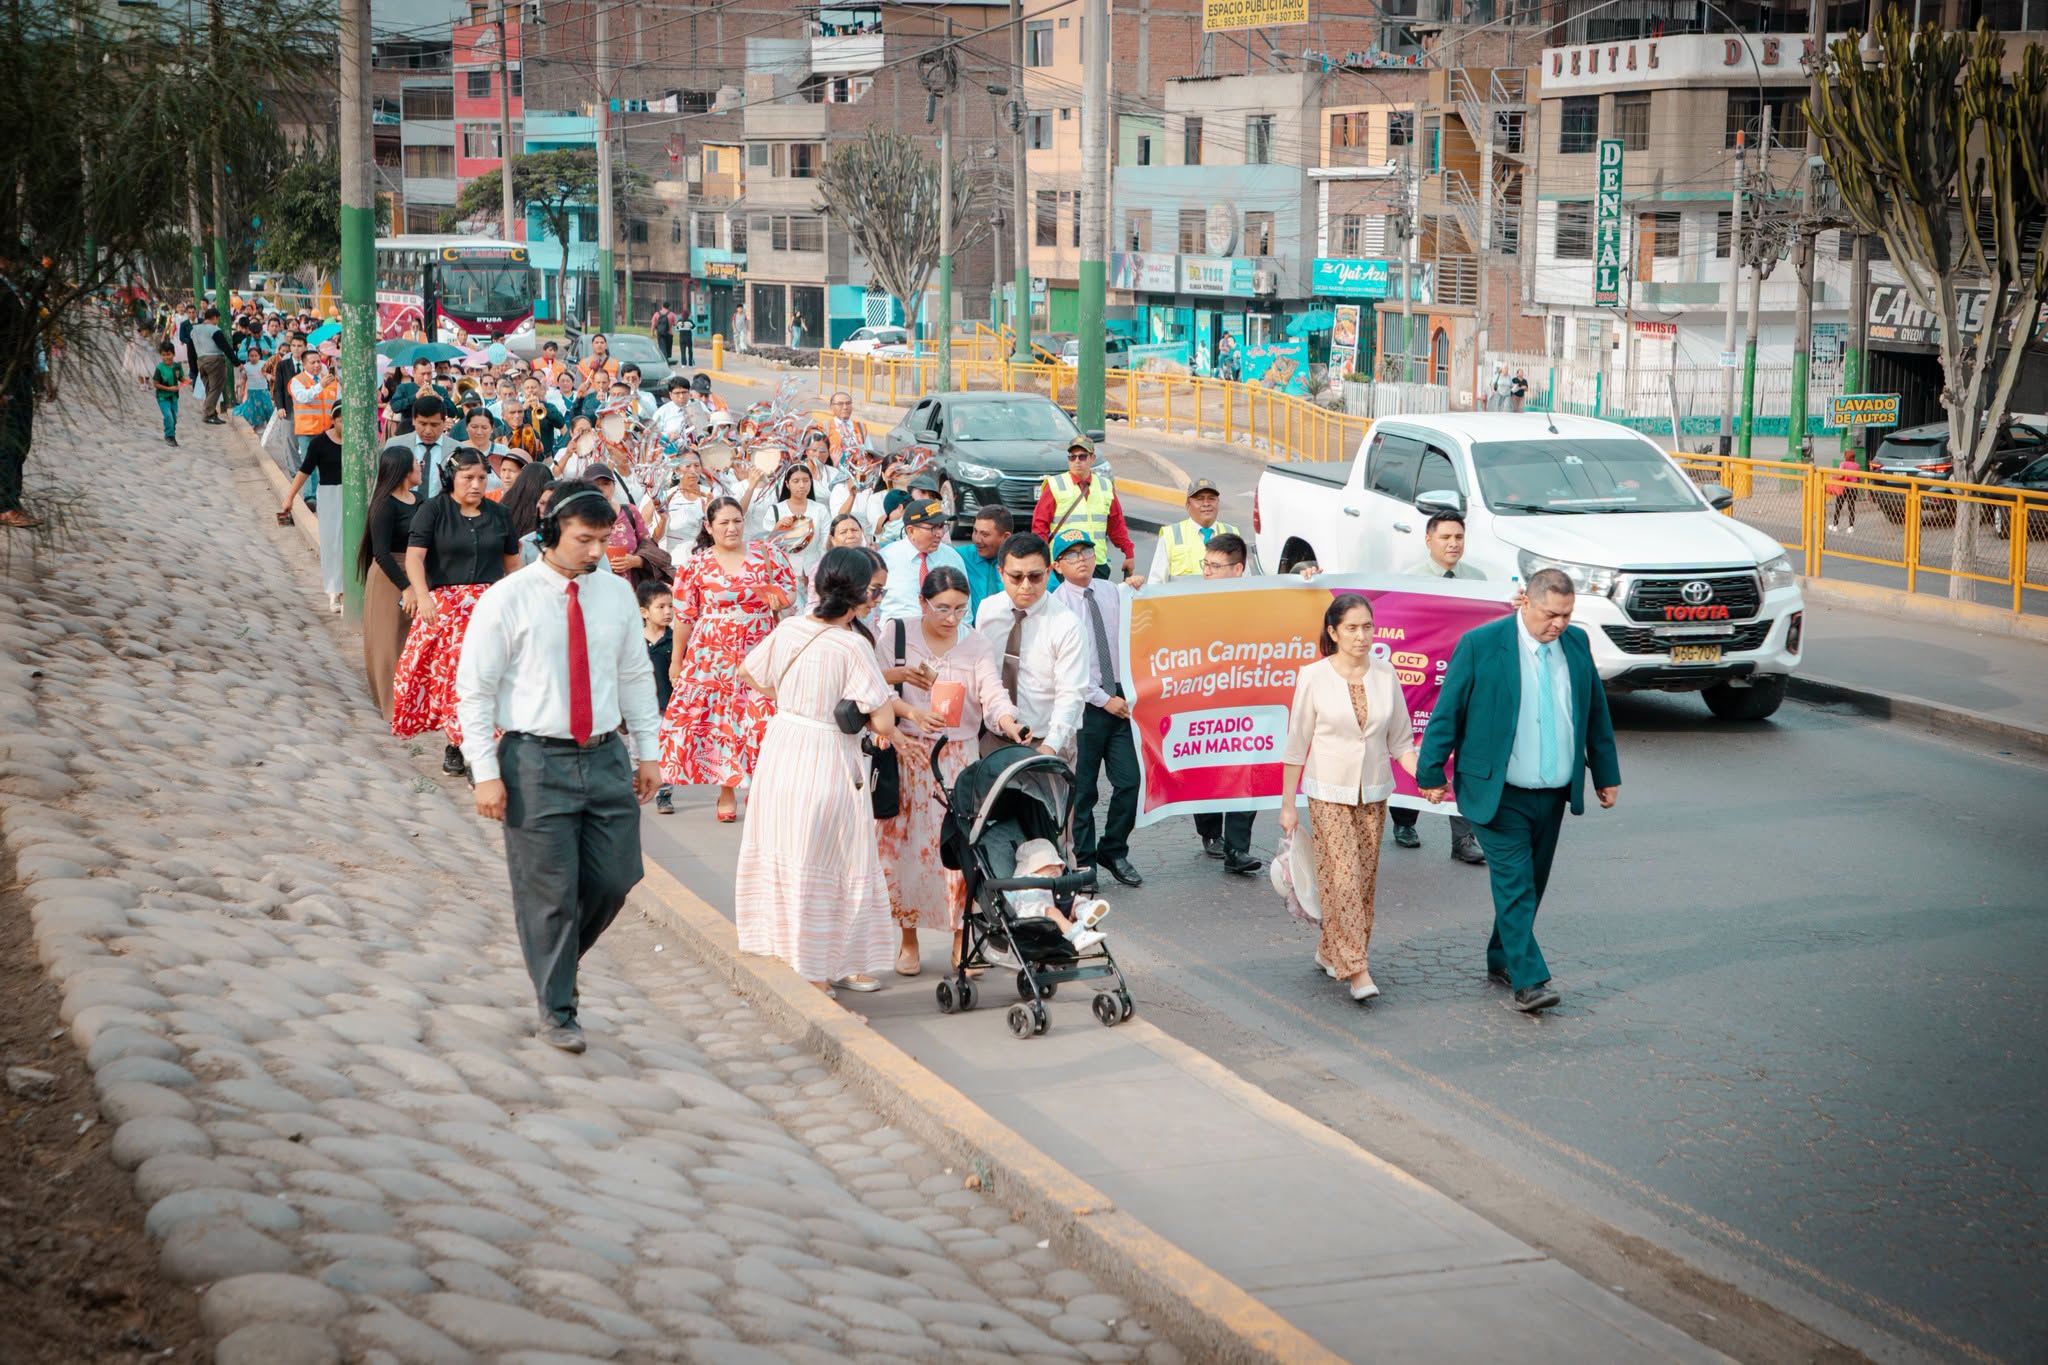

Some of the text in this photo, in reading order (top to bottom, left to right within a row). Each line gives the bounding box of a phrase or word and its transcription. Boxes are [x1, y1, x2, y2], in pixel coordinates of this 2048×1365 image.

[1208, 0, 1304, 16] ESPACIO PUBLICITARIO
[1265, 13, 1278, 23] 994
[1552, 43, 1660, 77] DENTAL
[1599, 143, 1621, 291] DENTAL
[442, 247, 459, 261] C
[511, 248, 525, 261] C
[1635, 320, 1678, 335] DENTISTA
[1901, 327, 1925, 342] GYEON
[1834, 398, 1897, 412] LAVADO
[1834, 412, 1896, 425] DE AUTOS
[1664, 605, 1729, 621] TOYOTA
[1150, 636, 1317, 677] ¡Gran Campaña
[1397, 655, 1422, 665] OCT
[1160, 664, 1304, 699] Evangelística
[1397, 672, 1422, 683] NOV
[1188, 716, 1254, 737] ESTADIO
[1173, 735, 1274, 758] SAN MARCOS
